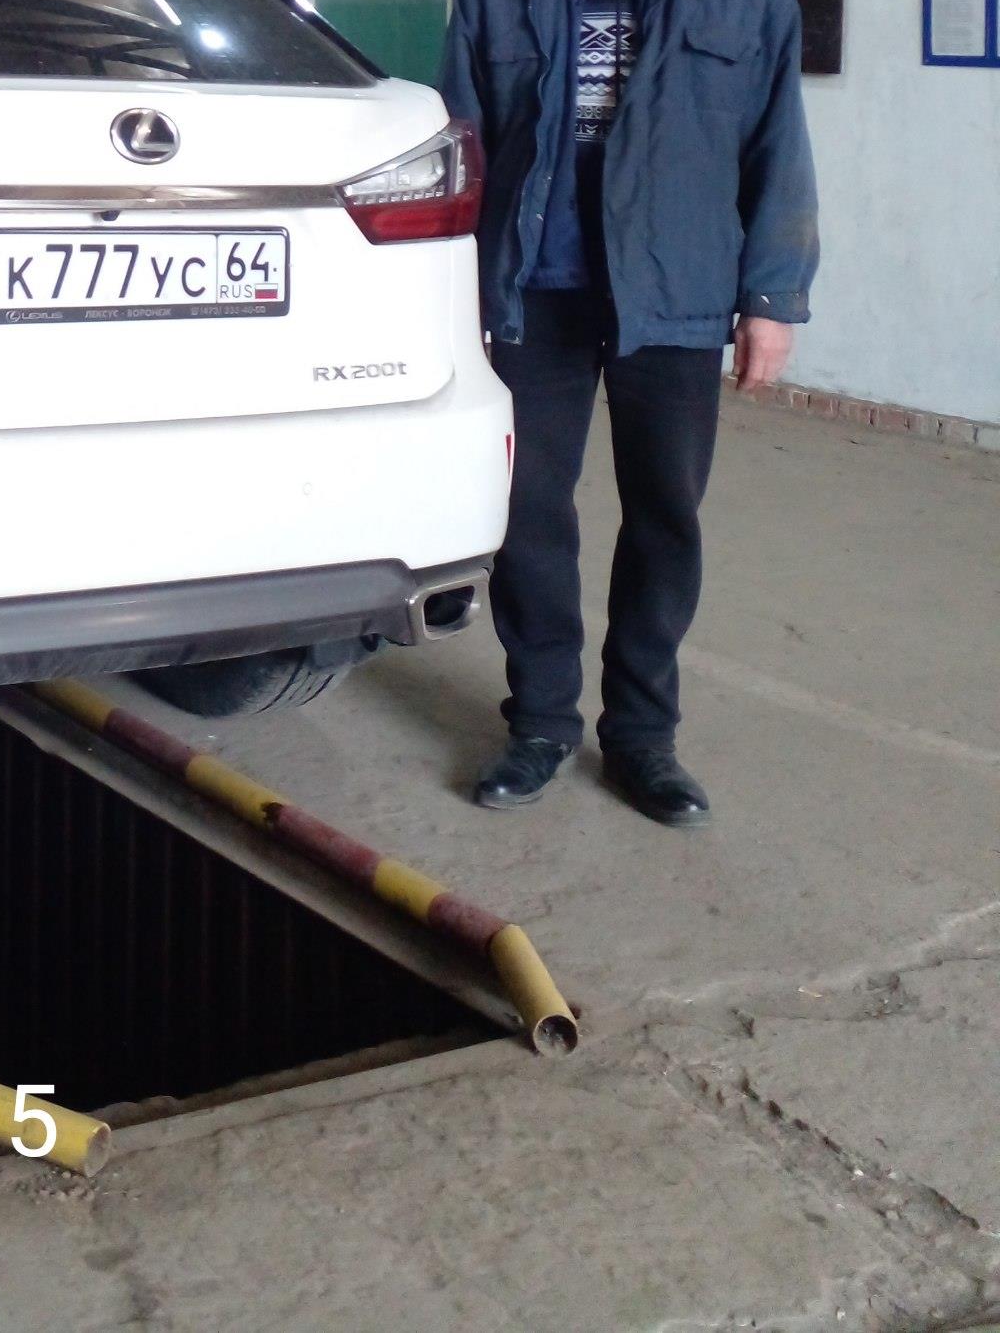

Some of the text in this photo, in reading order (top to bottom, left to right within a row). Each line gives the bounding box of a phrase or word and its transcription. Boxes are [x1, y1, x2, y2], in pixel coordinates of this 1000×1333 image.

[8, 242, 269, 299] К777УС 64
[220, 284, 253, 299] RUS
